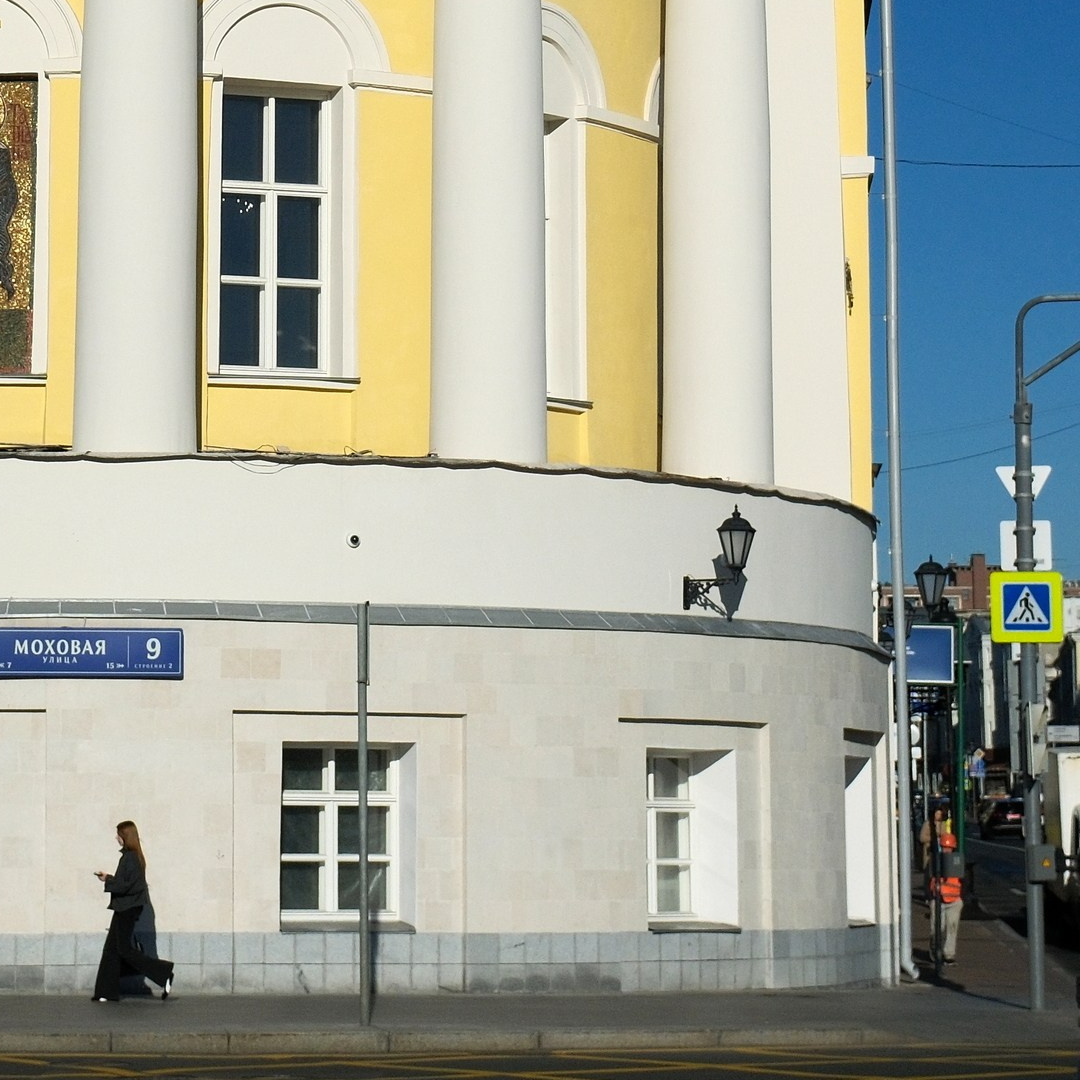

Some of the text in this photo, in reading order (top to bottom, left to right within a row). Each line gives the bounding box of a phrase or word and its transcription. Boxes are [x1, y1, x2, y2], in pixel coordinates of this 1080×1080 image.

[14, 639, 106, 655] МОХОВАЯ
[146, 637, 161, 660] 9
[42, 656, 78, 664] УЛИЦА
